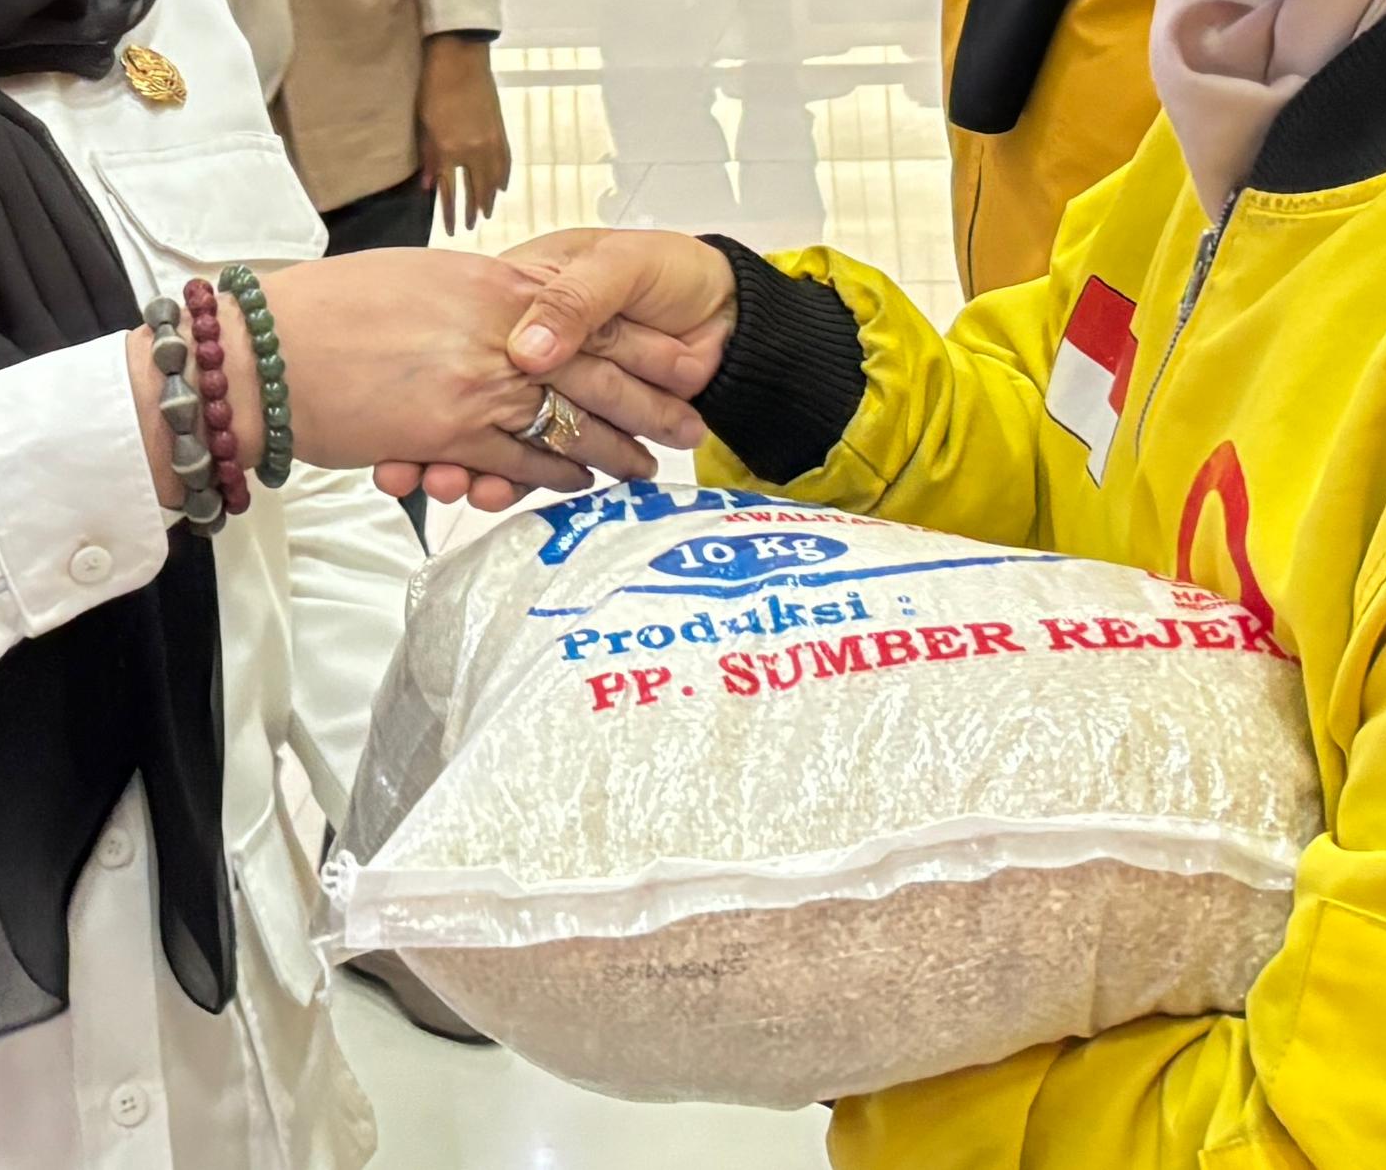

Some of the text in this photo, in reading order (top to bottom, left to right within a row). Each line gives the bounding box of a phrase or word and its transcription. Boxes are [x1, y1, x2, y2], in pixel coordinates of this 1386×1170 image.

[674, 534, 827, 570] 10 Kg
[557, 592, 872, 661] Produksi
[585, 665, 695, 712] PP.
[718, 620, 1026, 697] SUMBER
